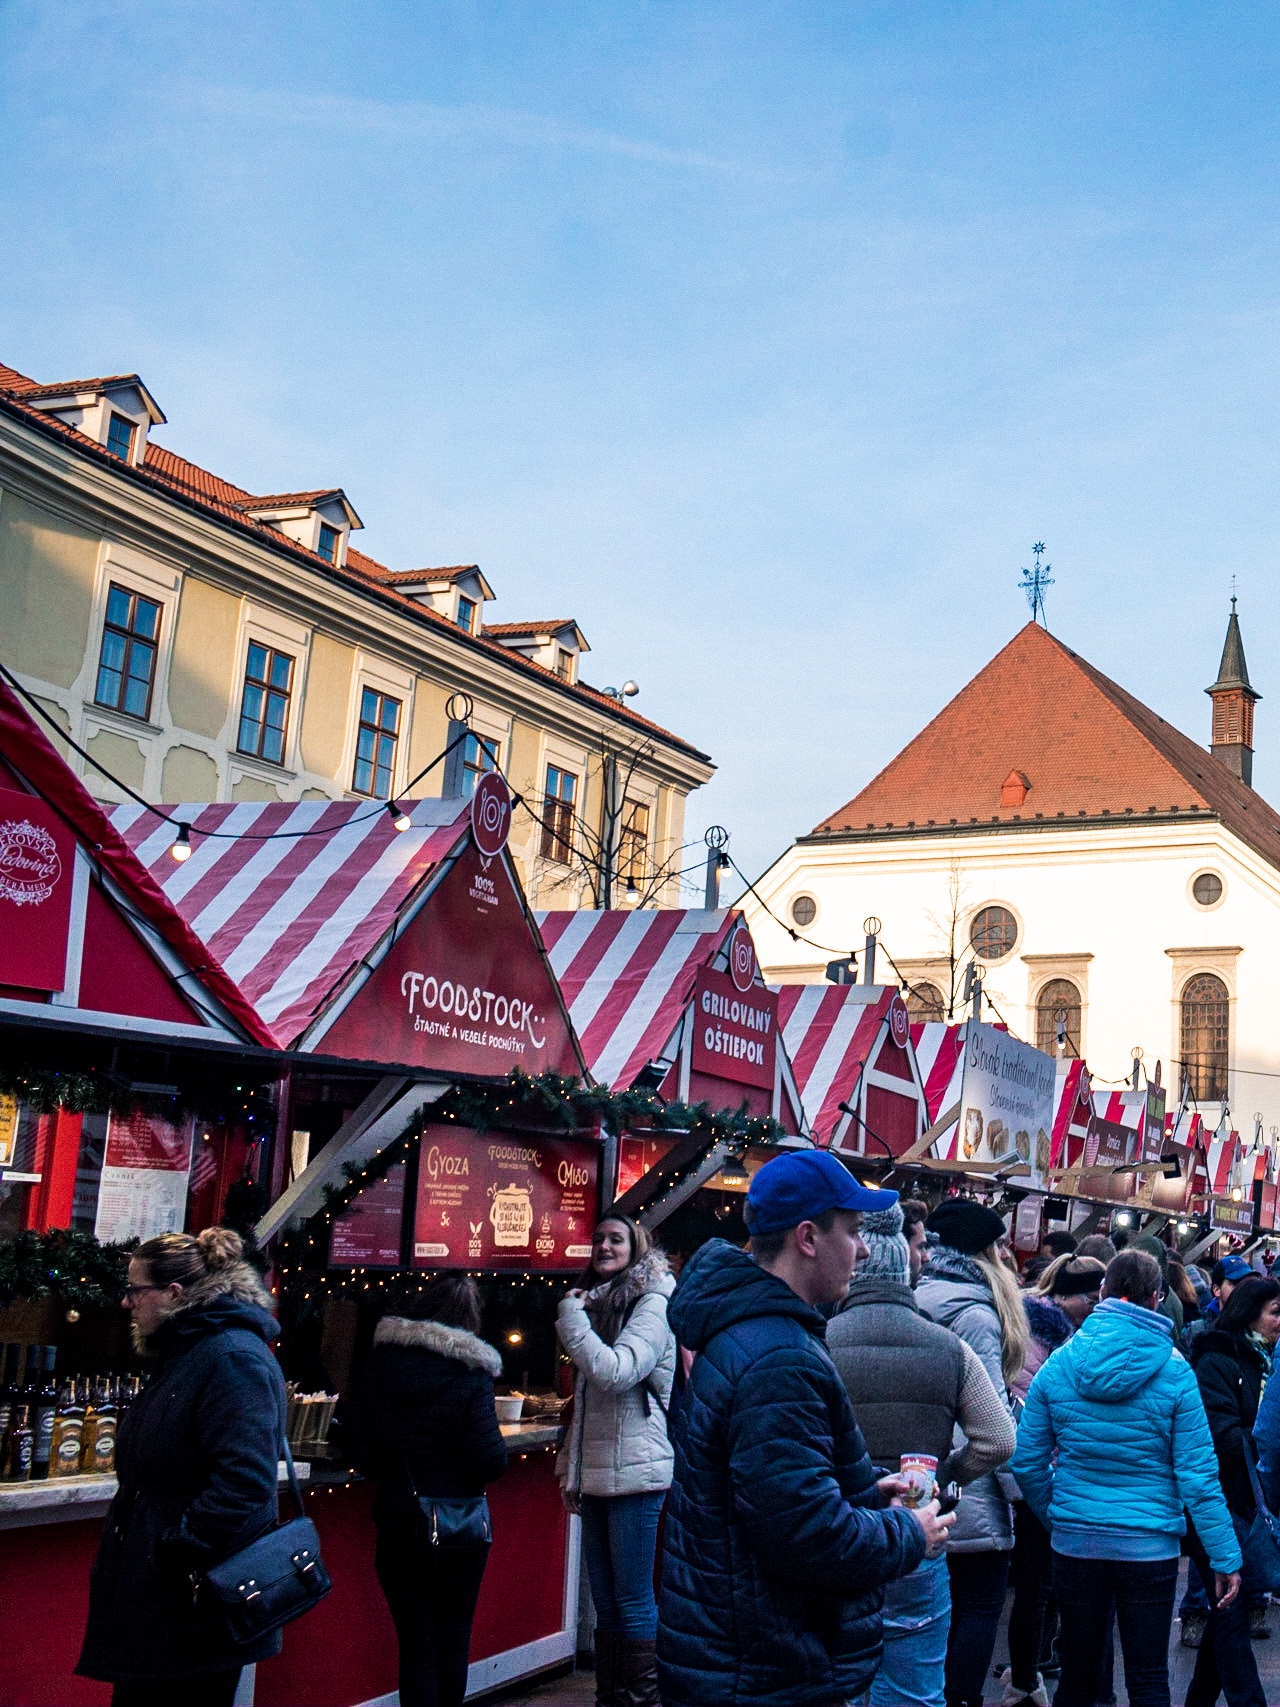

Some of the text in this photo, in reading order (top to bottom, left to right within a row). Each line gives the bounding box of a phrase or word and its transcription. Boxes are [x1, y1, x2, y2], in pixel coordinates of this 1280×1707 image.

[474, 874, 495, 894] 100%
[702, 990, 771, 1034] GRILOVANÝ
[452, 1026, 458, 1039] A
[460, 1028, 487, 1046] VESELÉ
[704, 1023, 764, 1066] OŠTIEPOK
[427, 1145, 469, 1181] GYOZA
[488, 1145, 542, 1168] FOODSTOCK
